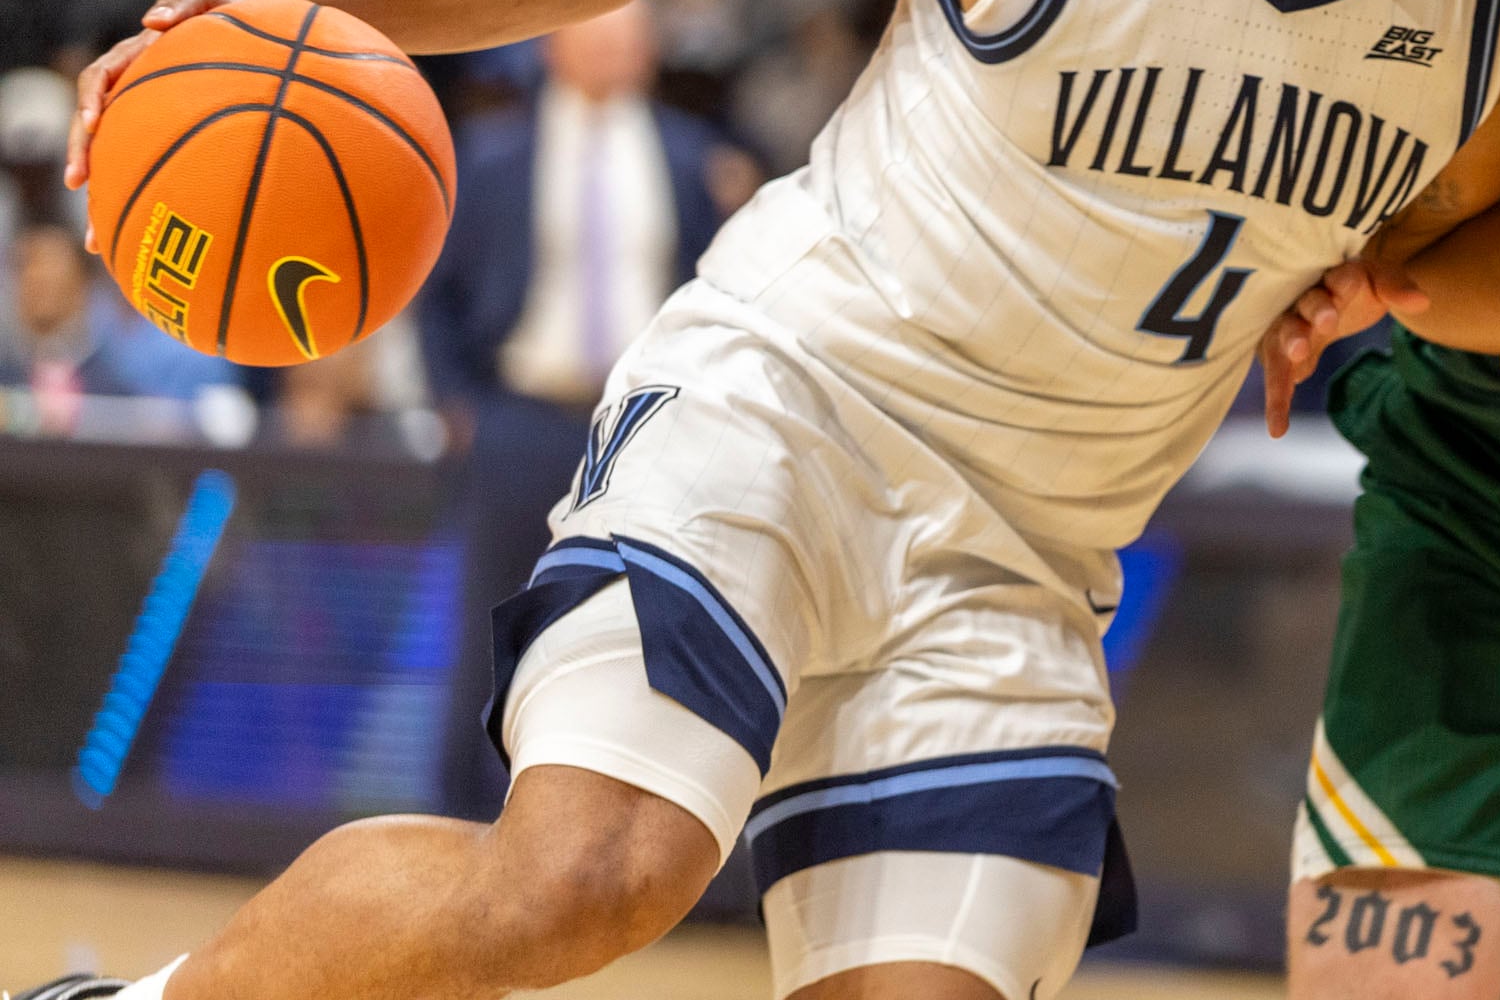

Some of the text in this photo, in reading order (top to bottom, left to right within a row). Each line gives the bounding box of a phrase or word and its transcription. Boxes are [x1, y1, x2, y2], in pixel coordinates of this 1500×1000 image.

[1371, 39, 1443, 61] EAST
[1383, 25, 1435, 45] BIG
[1047, 66, 1429, 235] VILLANOVA
[1135, 209, 1257, 367] 4
[1306, 884, 1482, 978] 2003
